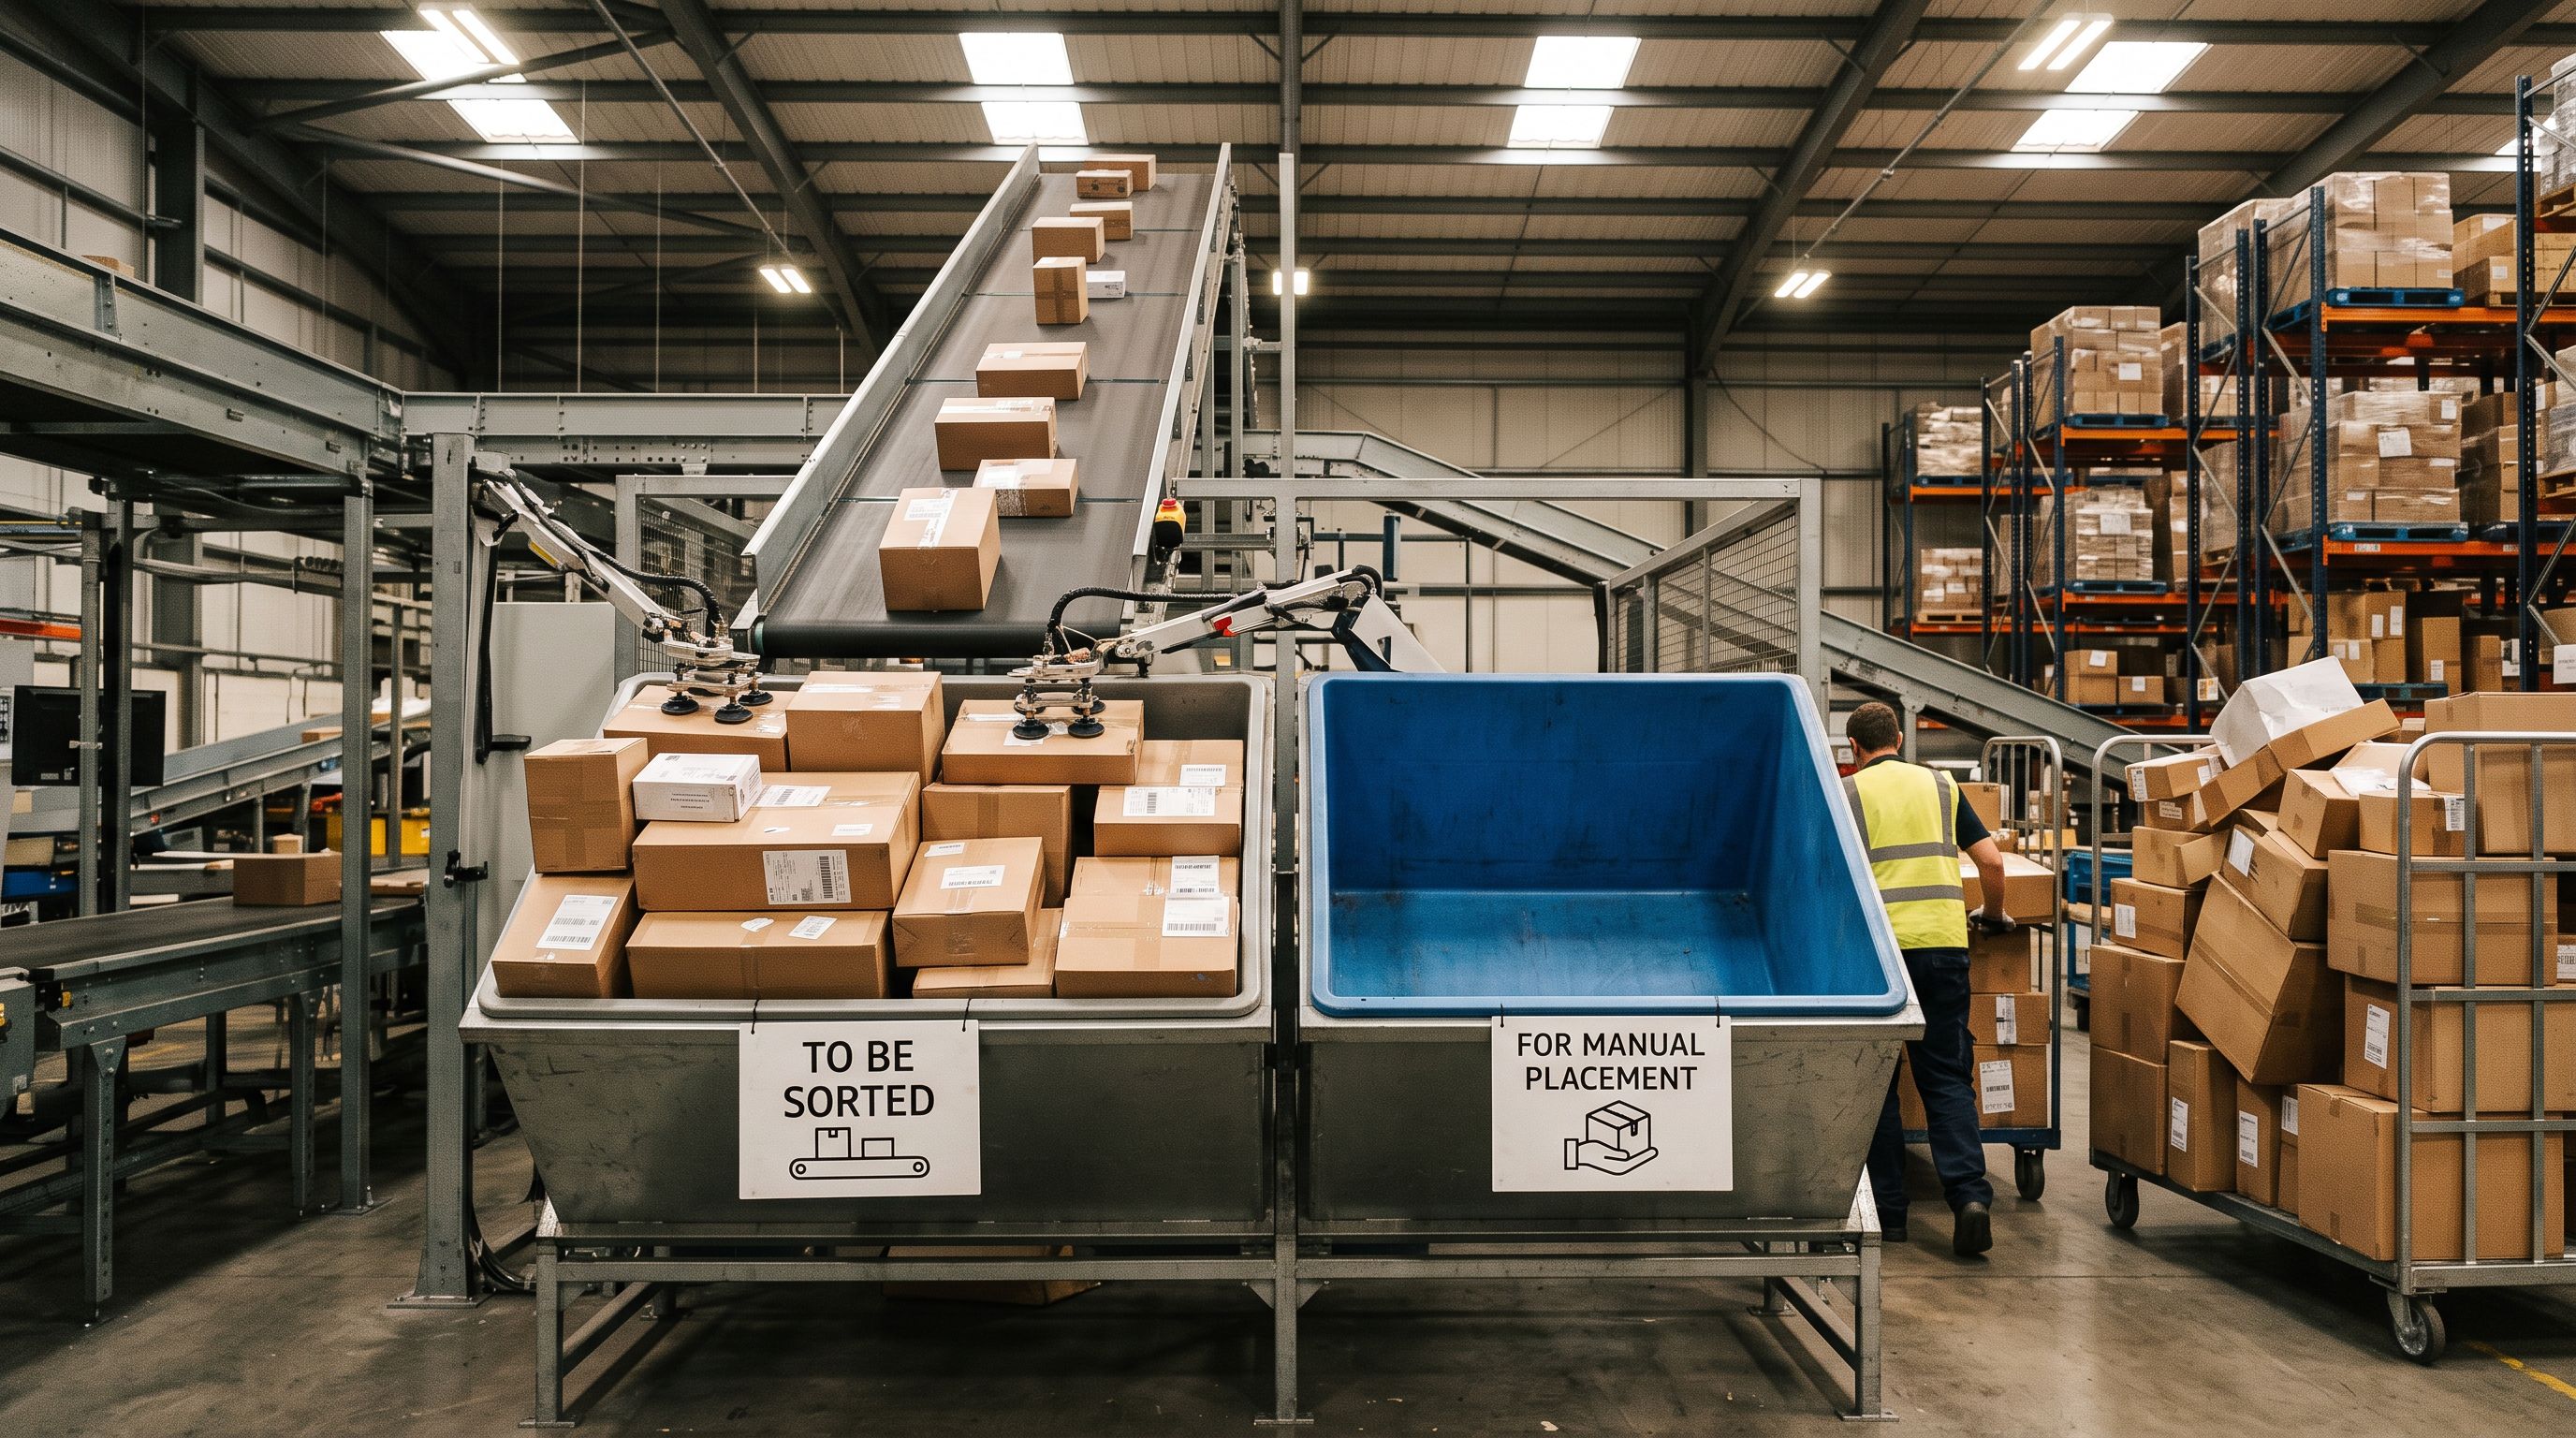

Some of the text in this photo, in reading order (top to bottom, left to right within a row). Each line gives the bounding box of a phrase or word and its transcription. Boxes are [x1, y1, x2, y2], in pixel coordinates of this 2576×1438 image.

[802, 1039, 915, 1074] TO BE
[1517, 1032, 1705, 1057] FOR MANUAL
[1526, 1065, 1698, 1091] PLACEMENT
[783, 1084, 935, 1119] SORTED
